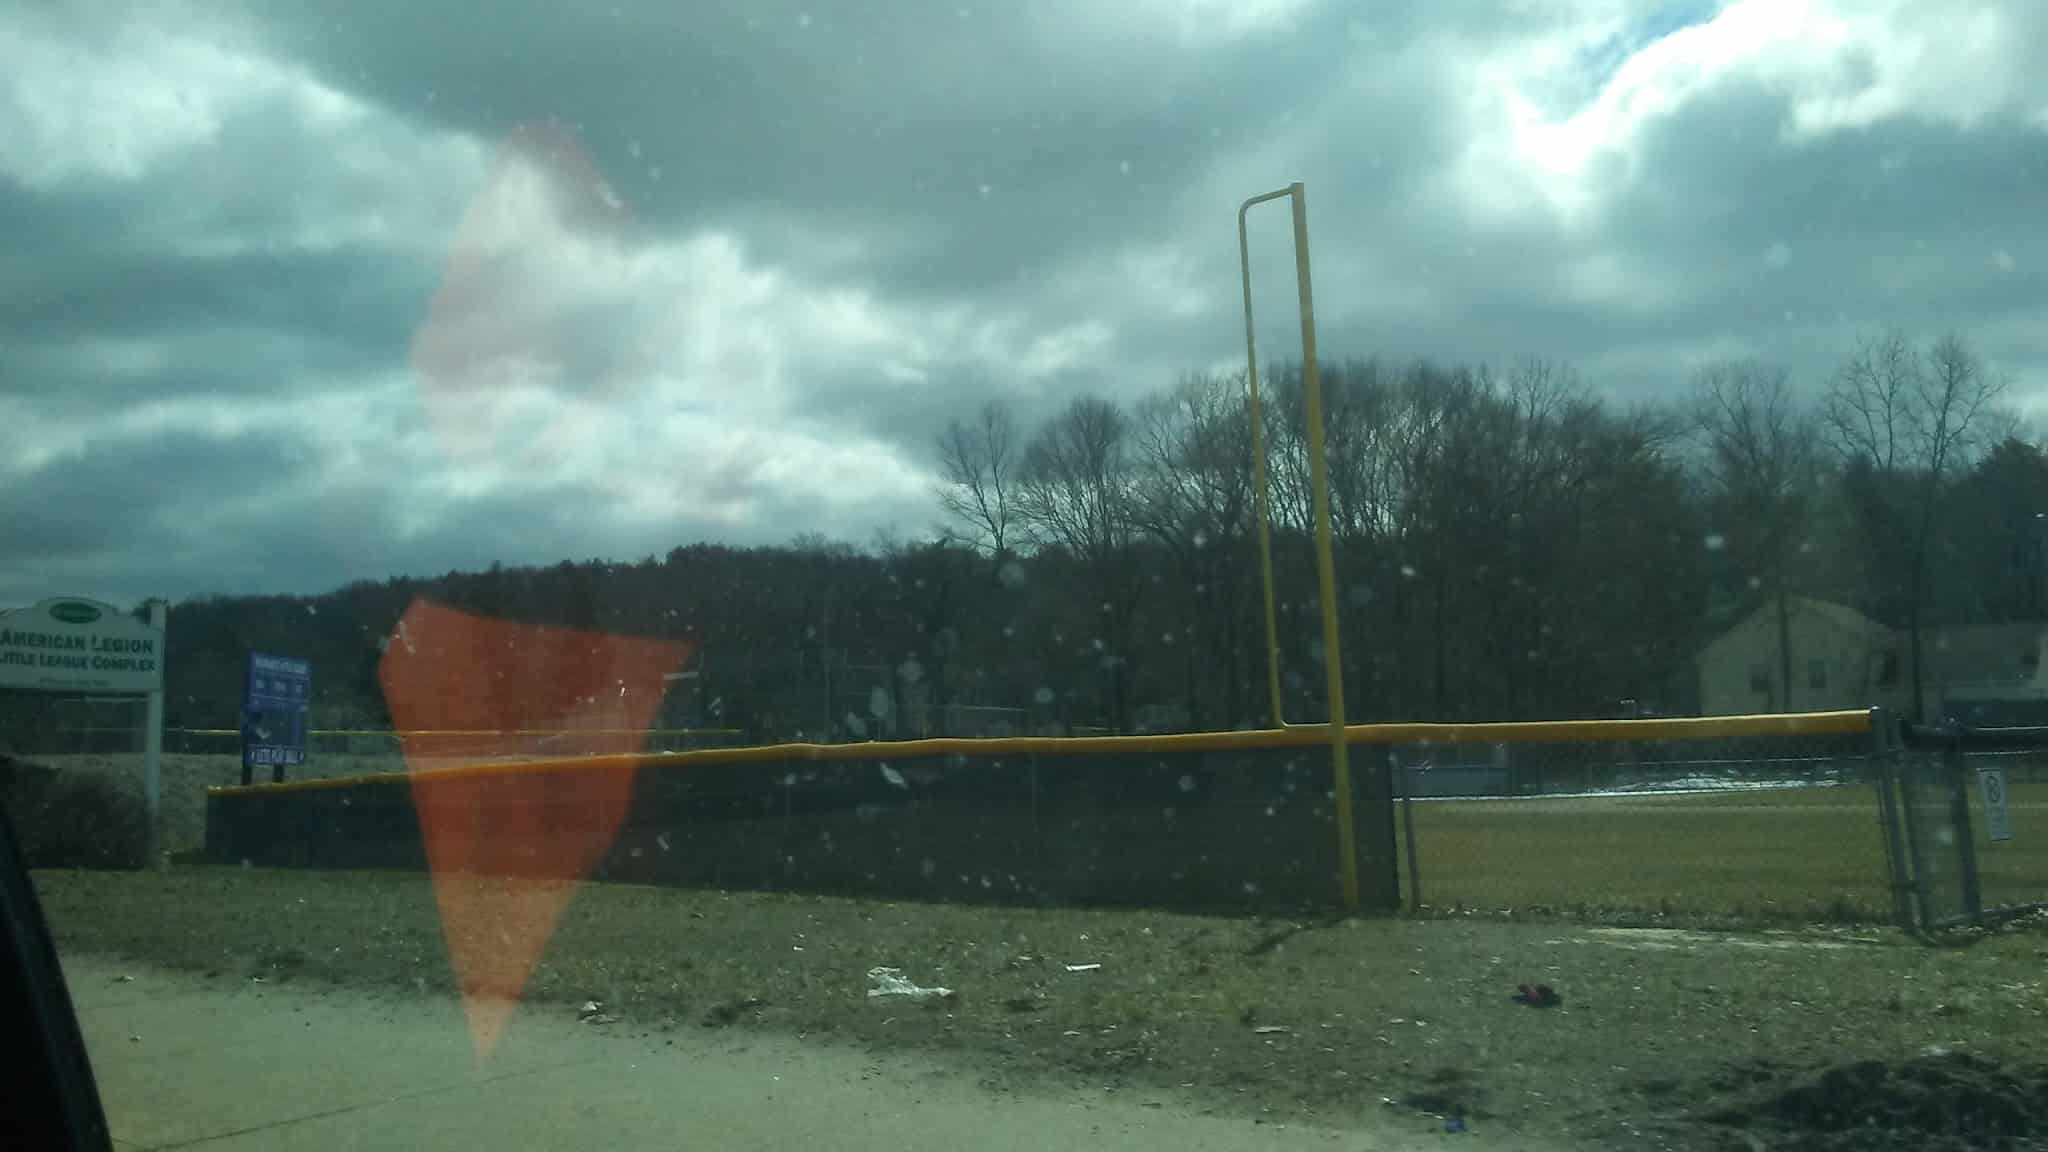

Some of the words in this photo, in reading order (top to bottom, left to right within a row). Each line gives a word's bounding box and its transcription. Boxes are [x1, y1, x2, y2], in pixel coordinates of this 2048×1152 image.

[0, 629, 86, 650] AMERICAN
[91, 634, 154, 653] LEGION
[40, 653, 89, 670] LEAGUE
[93, 656, 155, 672] COMPLEX
